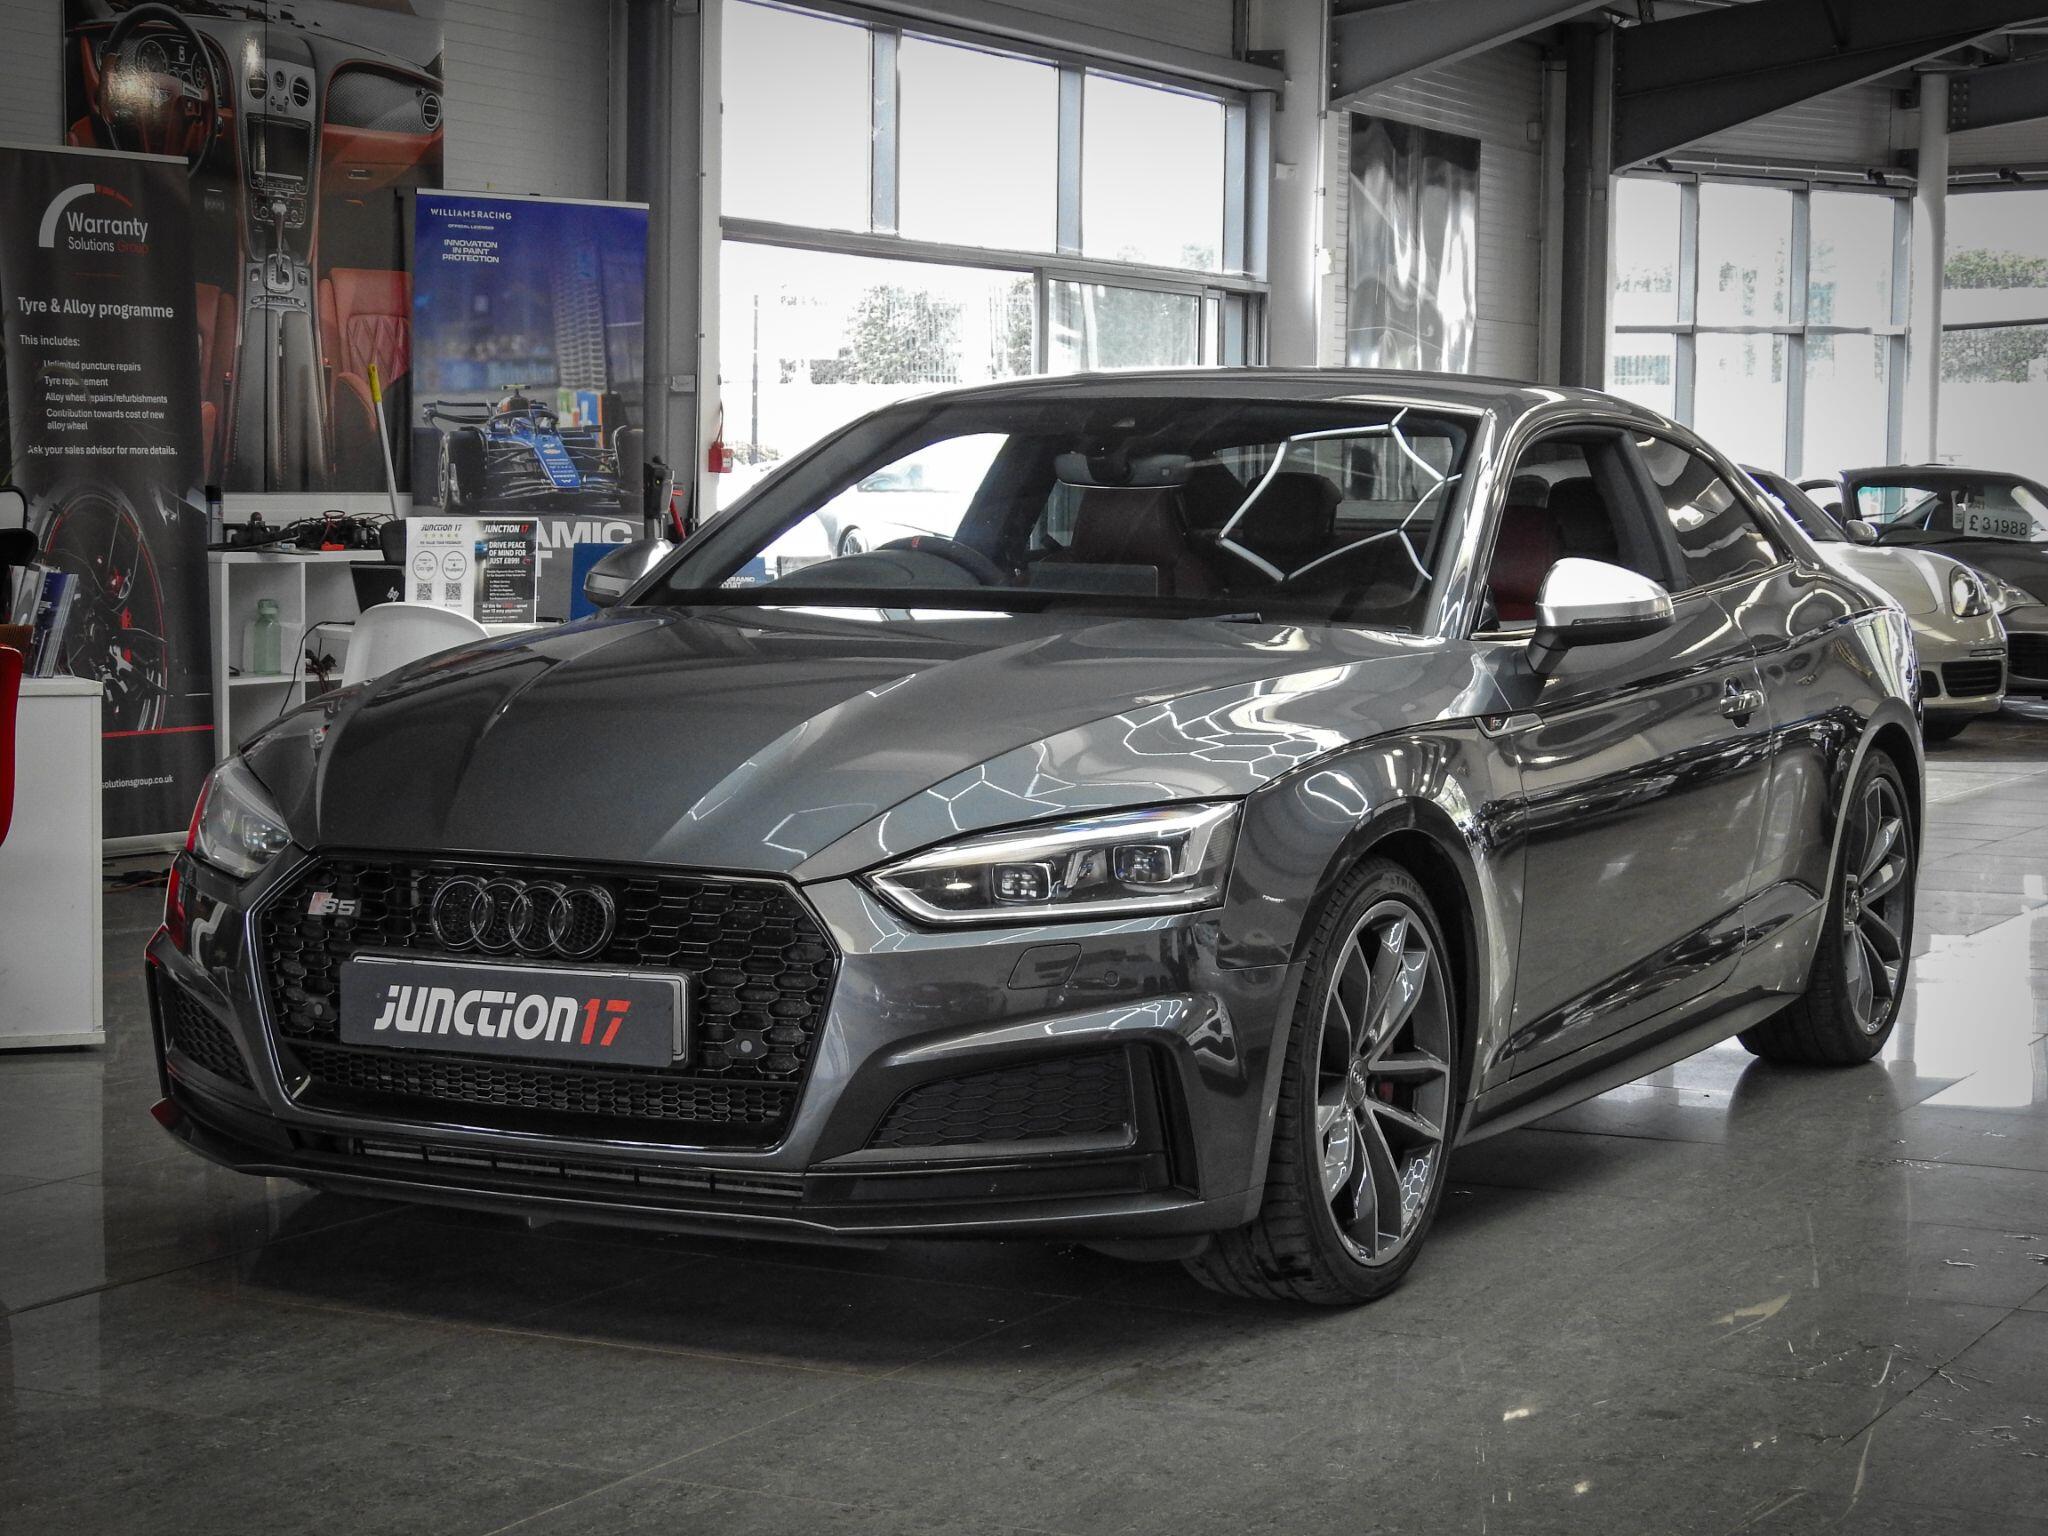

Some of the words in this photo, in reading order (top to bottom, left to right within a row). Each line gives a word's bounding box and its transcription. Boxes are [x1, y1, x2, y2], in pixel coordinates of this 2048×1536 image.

[66, 211, 149, 243] Warranty
[68, 236, 115, 252] Solutions
[443, 239, 498, 248] INNOVATION
[463, 247, 490, 255] PAINT
[442, 254, 499, 263] PROTECTION
[17, 296, 47, 315] Tyre
[50, 298, 60, 313] &
[63, 299, 96, 318] Alloy
[99, 303, 174, 320] programme
[19, 334, 38, 345] This
[40, 335, 81, 347] includes:
[80, 361, 116, 371] puncture
[116, 362, 142, 372] repairs
[44, 375, 61, 387] Tyre
[61, 377, 109, 387] repement
[45, 392, 65, 403] Alloy
[65, 393, 87, 402] wheel
[89, 394, 168, 404] epairs/refurbishments
[46, 408, 93, 419] Contribution
[93, 409, 124, 419] towards
[125, 411, 141, 419] cost
[142, 410, 150, 419] of
[150, 411, 165, 419] new
[47, 422, 66, 432] alloy
[66, 422, 88, 430] wheel
[27, 445, 43, 454] Ask
[44, 446, 64, 456] your
[64, 445, 85, 455] sales
[85, 445, 116, 455] advisor
[116, 445, 128, 455] for
[129, 447, 149, 455] more
[149, 445, 178, 455] details.
[484, 524, 519, 533] JUNCTION
[520, 524, 529, 533] 17
[489, 541, 506, 549] DRIVE
[507, 541, 526, 549] PEACE
[489, 557, 502, 565] JUST
